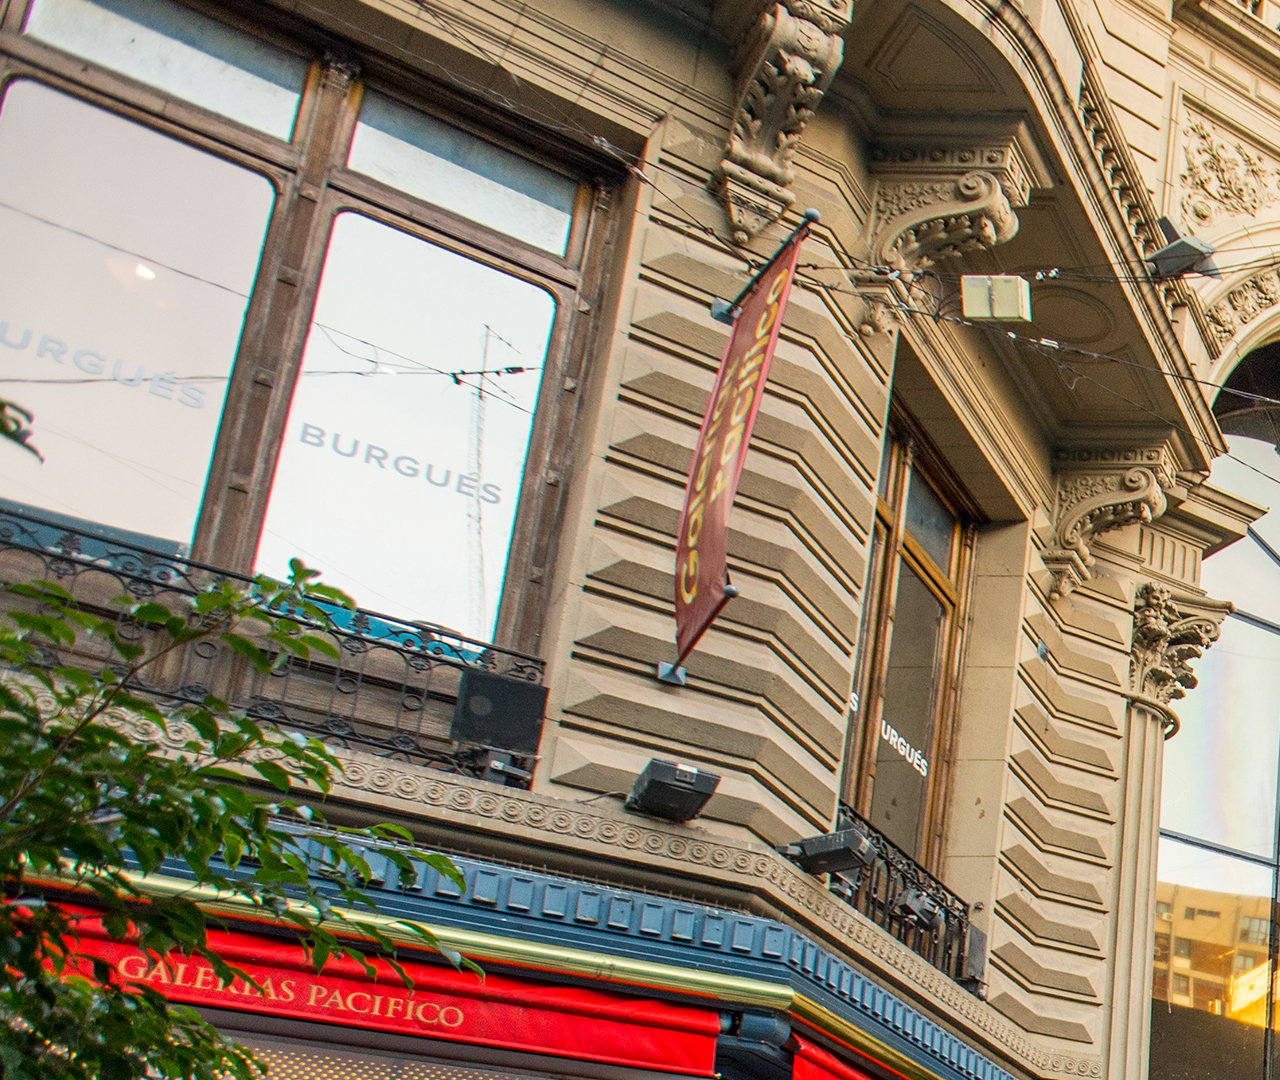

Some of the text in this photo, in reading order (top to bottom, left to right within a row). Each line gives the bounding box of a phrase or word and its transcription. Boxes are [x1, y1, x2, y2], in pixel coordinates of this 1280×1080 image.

[0, 320, 206, 409] URGUÉS
[880, 720, 928, 777] URGUÉS
[306, 984, 464, 1027] PACIFICO
